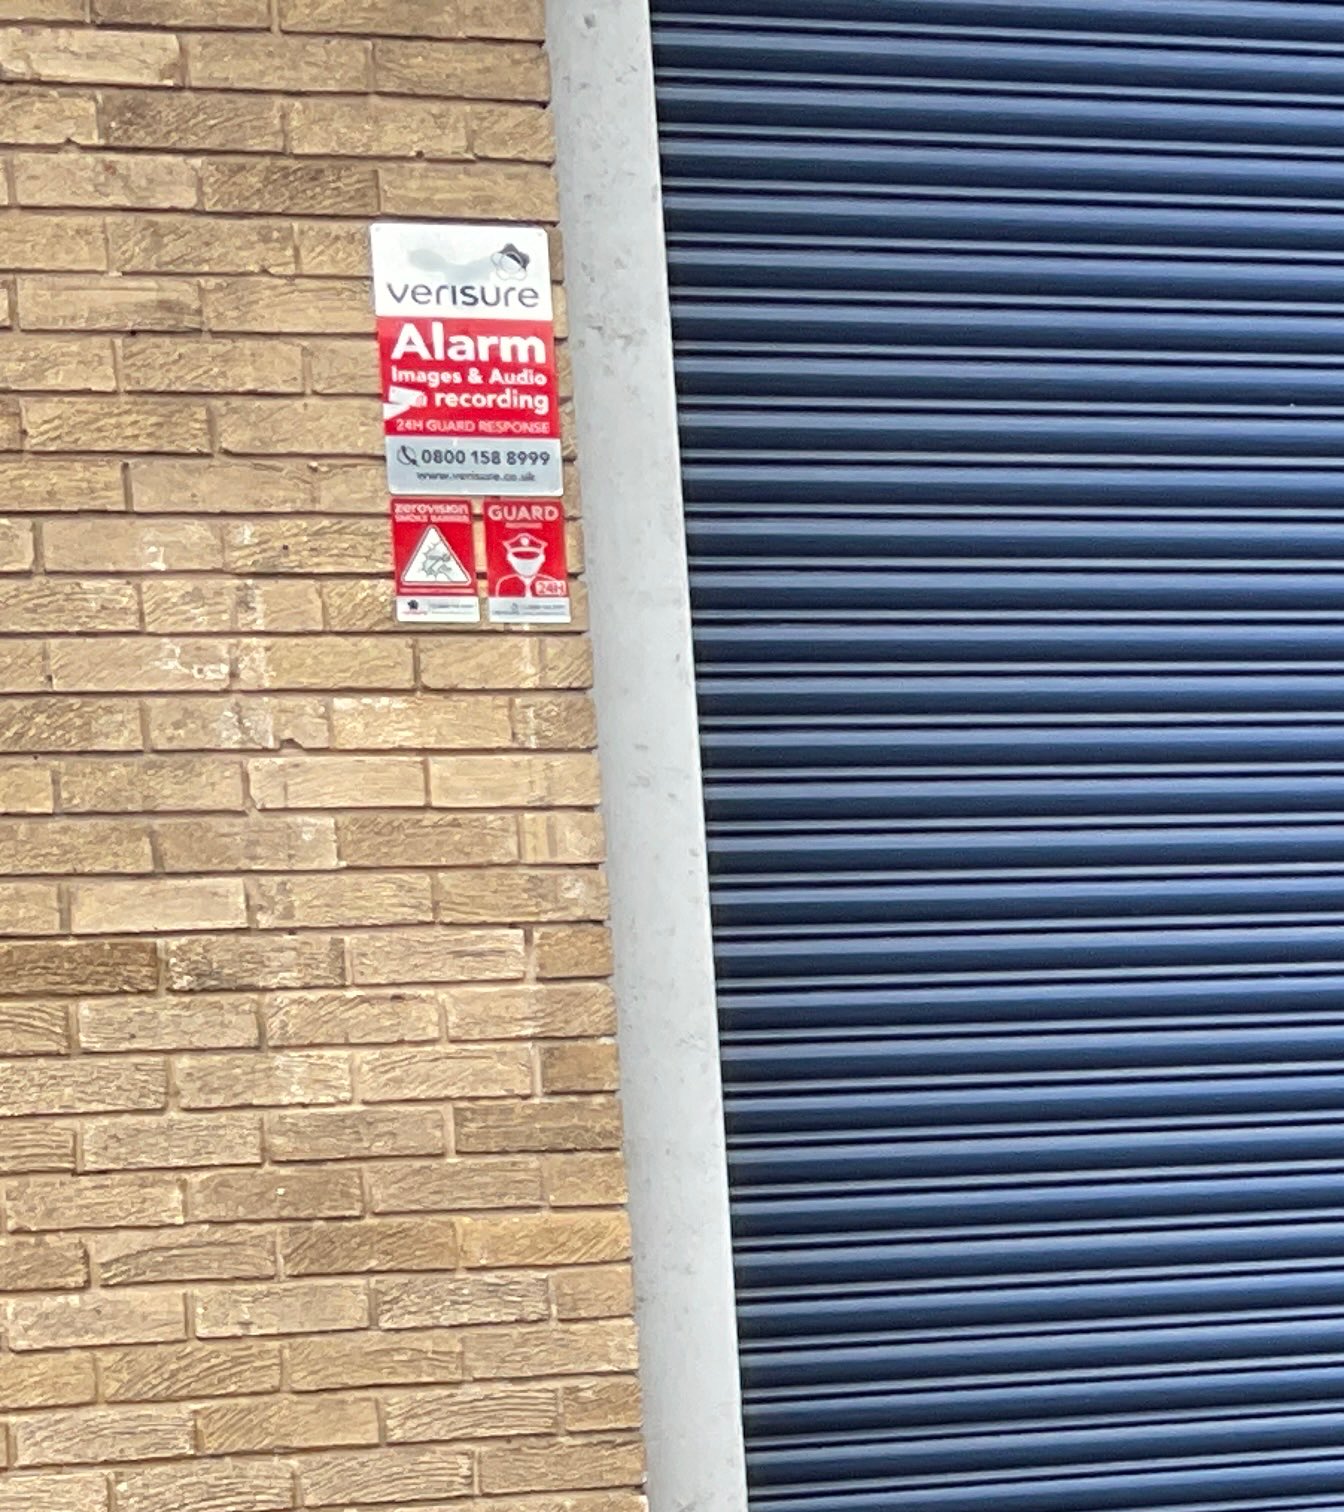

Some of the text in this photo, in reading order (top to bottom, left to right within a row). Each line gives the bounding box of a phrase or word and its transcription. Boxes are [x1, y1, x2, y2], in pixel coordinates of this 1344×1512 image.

[386, 282, 540, 308] verisure
[390, 321, 547, 364] Alarm
[391, 365, 547, 387] Images & Audio
[434, 387, 549, 415] recording
[396, 418, 550, 434] 24H GUARD RESPONSE
[421, 449, 551, 466] 0800 158 8999
[487, 504, 560, 522] GUARD
